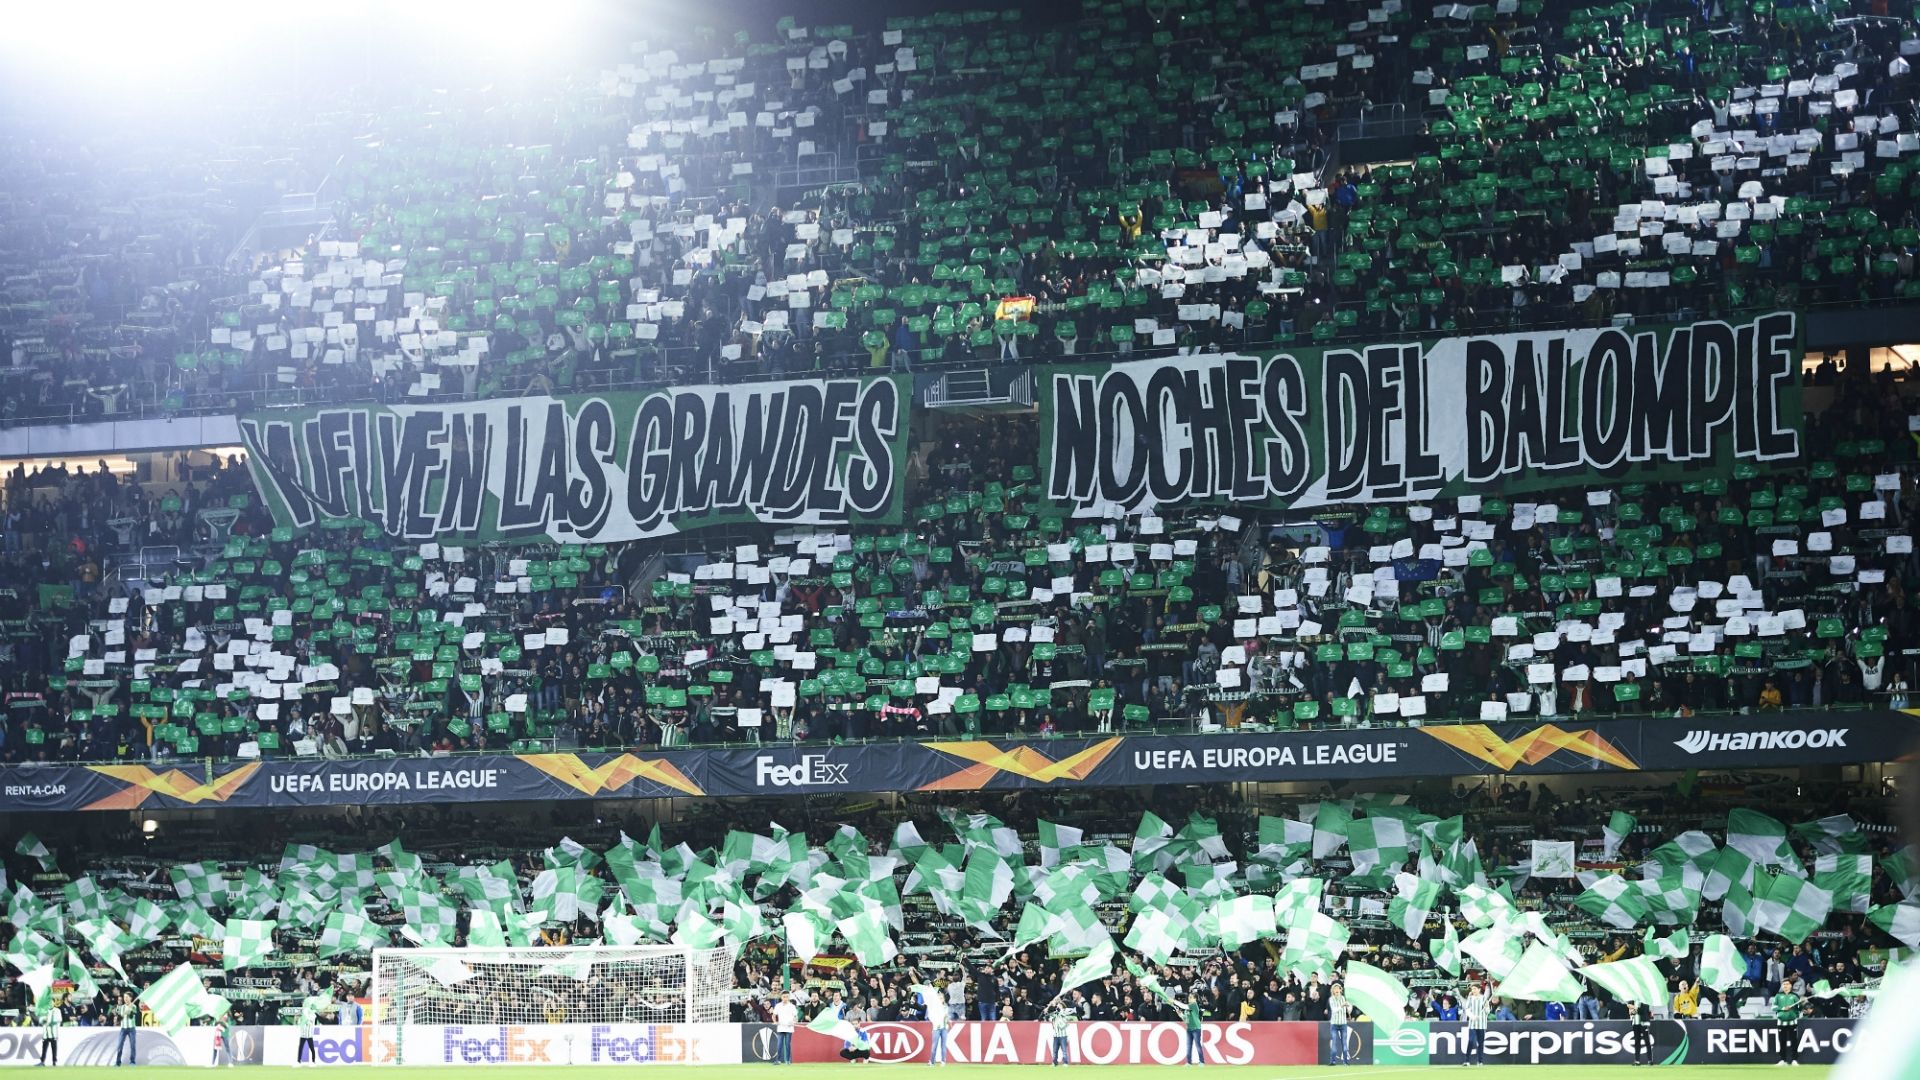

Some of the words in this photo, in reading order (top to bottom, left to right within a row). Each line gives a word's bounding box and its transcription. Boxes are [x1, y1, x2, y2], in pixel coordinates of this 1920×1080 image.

[1048, 353, 1312, 505] NOCHES
[1321, 342, 1444, 500] DEL
[1464, 311, 1801, 484] BALOMPIE
[497, 398, 616, 532] LAS
[625, 376, 899, 528] GRANDES
[756, 754, 849, 786] FedEx
[1134, 749, 1197, 770] UEFA
[1203, 746, 1297, 768] EUROPA
[1302, 742, 1397, 766] LEAGUE
[5, 784, 67, 796] RENT-A-CAR
[270, 774, 325, 793] UEFA
[329, 771, 411, 791] EUROPA
[415, 769, 498, 789] LEAGUE
[443, 1026, 552, 1064] FedEx
[867, 1031, 913, 1054] KIA
[935, 1022, 1019, 1063] KIA
[1034, 1021, 1256, 1065] MOTORS
[1388, 1022, 1656, 1064] enterprise
[1707, 1028, 1872, 1054] RENT-A-C
